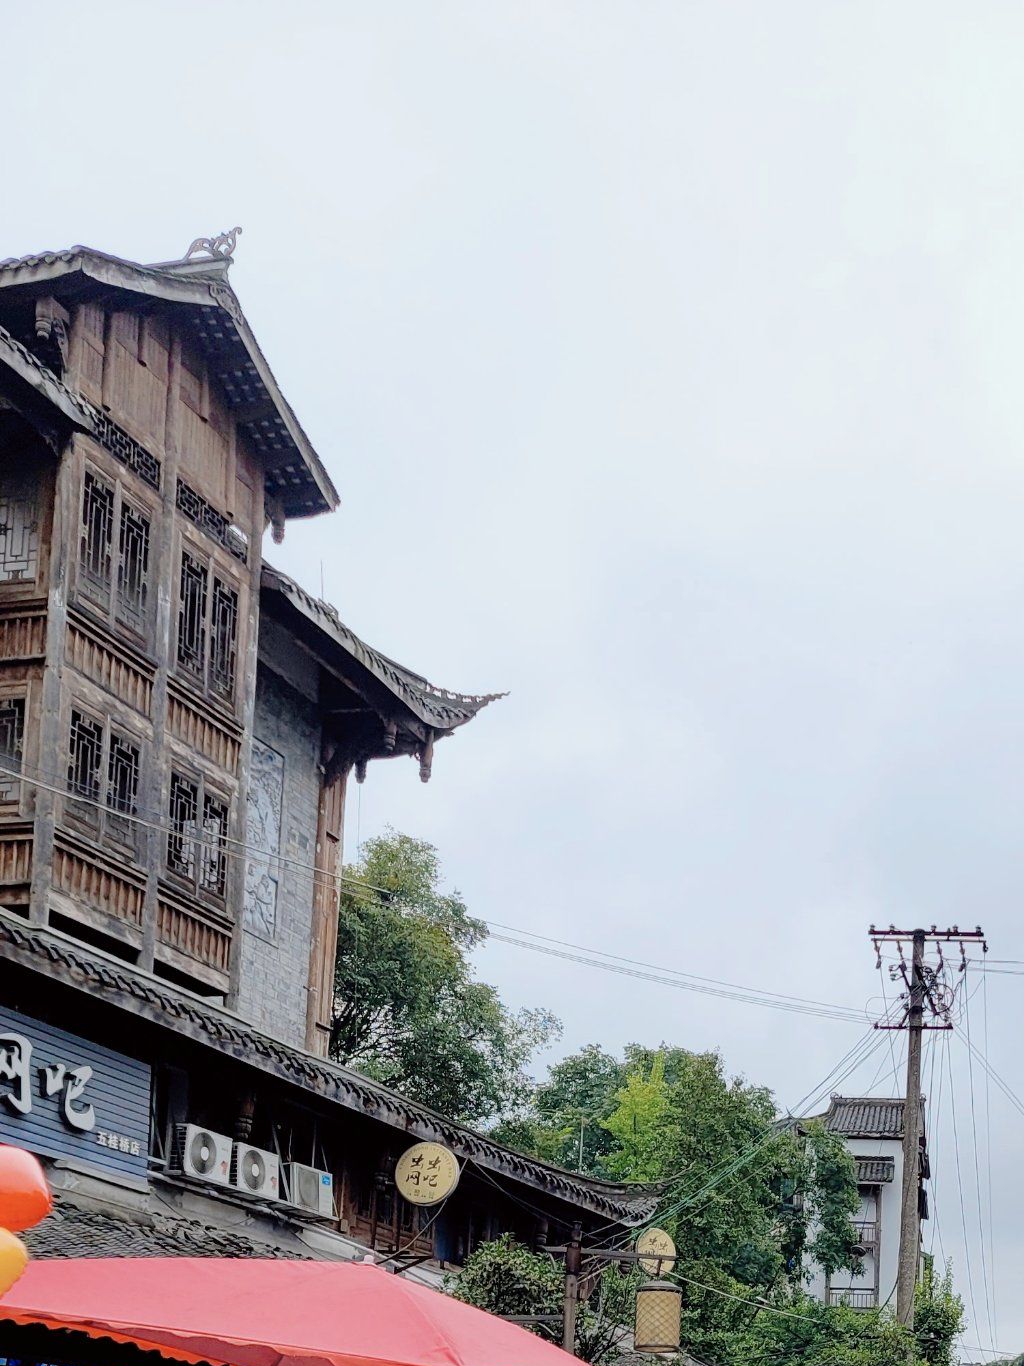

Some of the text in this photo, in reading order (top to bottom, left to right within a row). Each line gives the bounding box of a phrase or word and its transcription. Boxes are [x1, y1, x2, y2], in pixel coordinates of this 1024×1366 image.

[96, 1130, 141, 1157] 五桂桥店
[405, 1170, 438, 1188] 网吧
